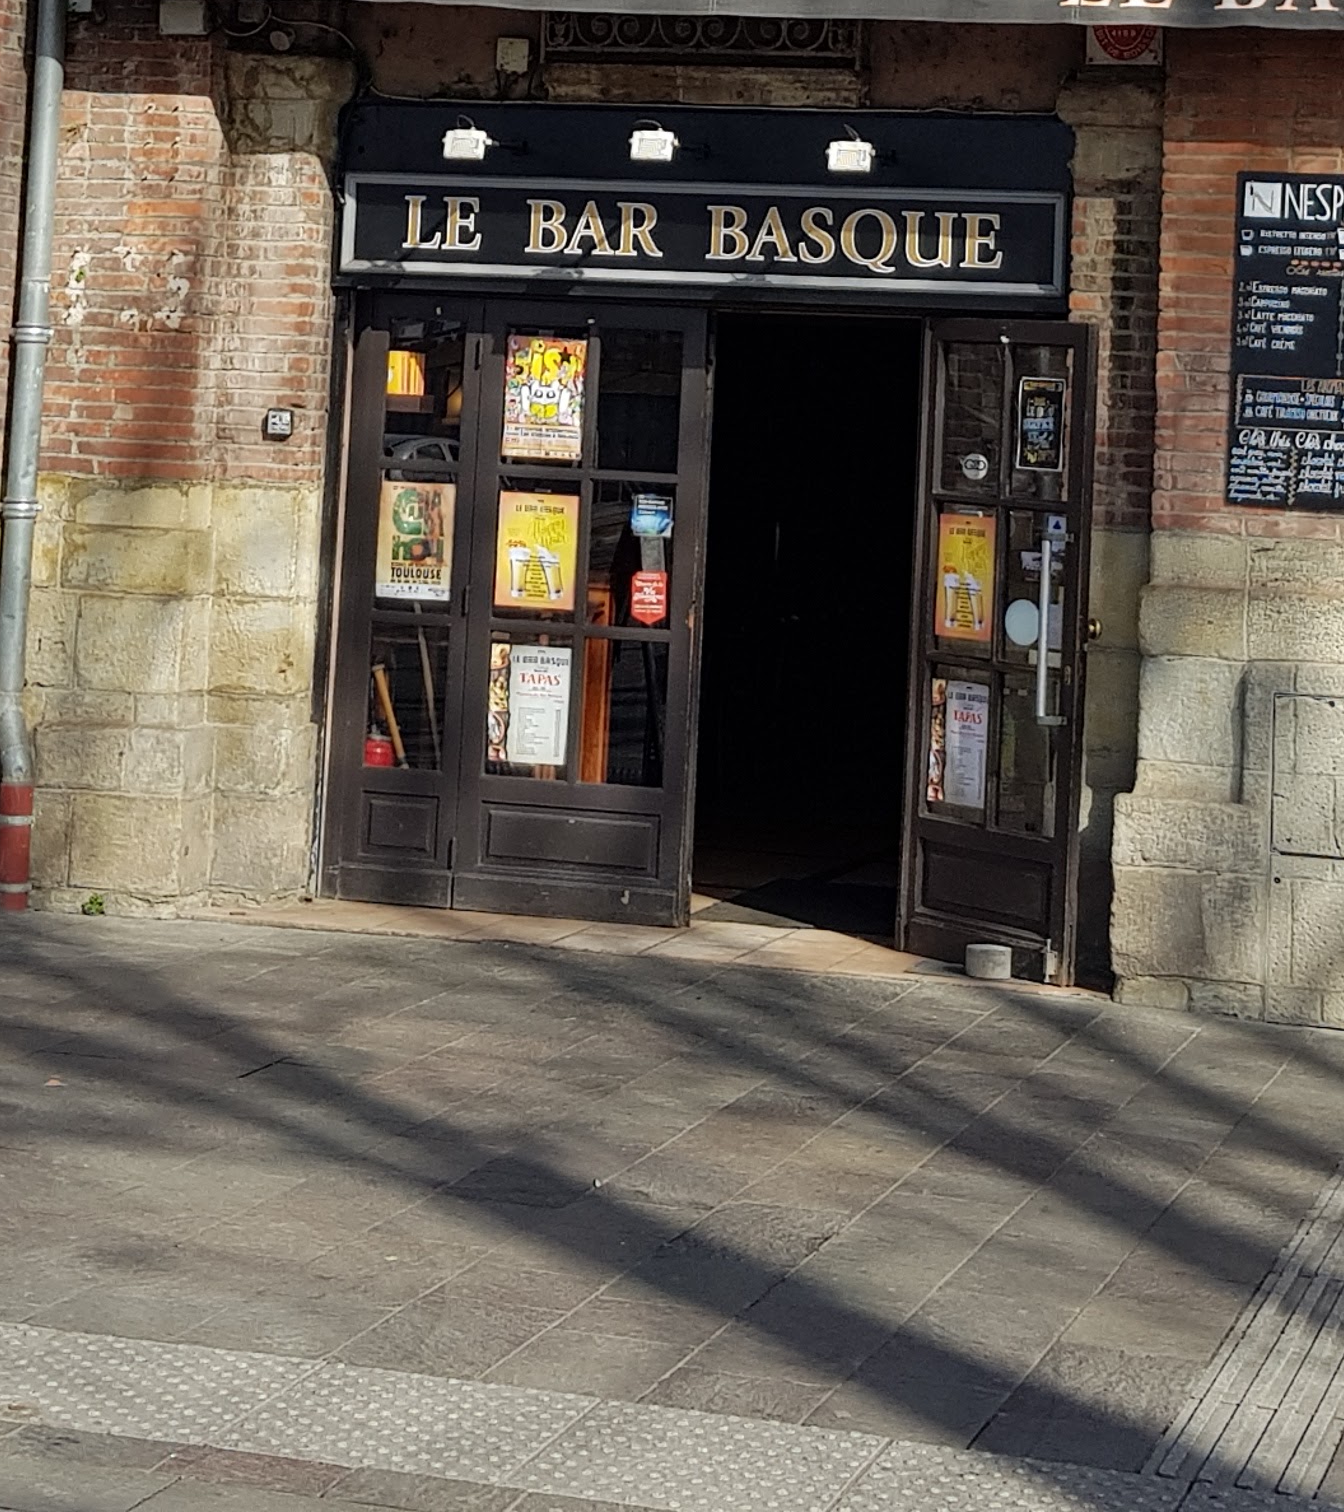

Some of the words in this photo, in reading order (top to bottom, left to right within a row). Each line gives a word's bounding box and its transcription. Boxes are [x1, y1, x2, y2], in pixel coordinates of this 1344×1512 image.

[402, 194, 483, 252] LE
[525, 199, 664, 259] BAR
[705, 205, 1003, 273] BASQUE
[390, 567, 441, 580] TOULOUSE
[519, 672, 561, 687] TAPAS
